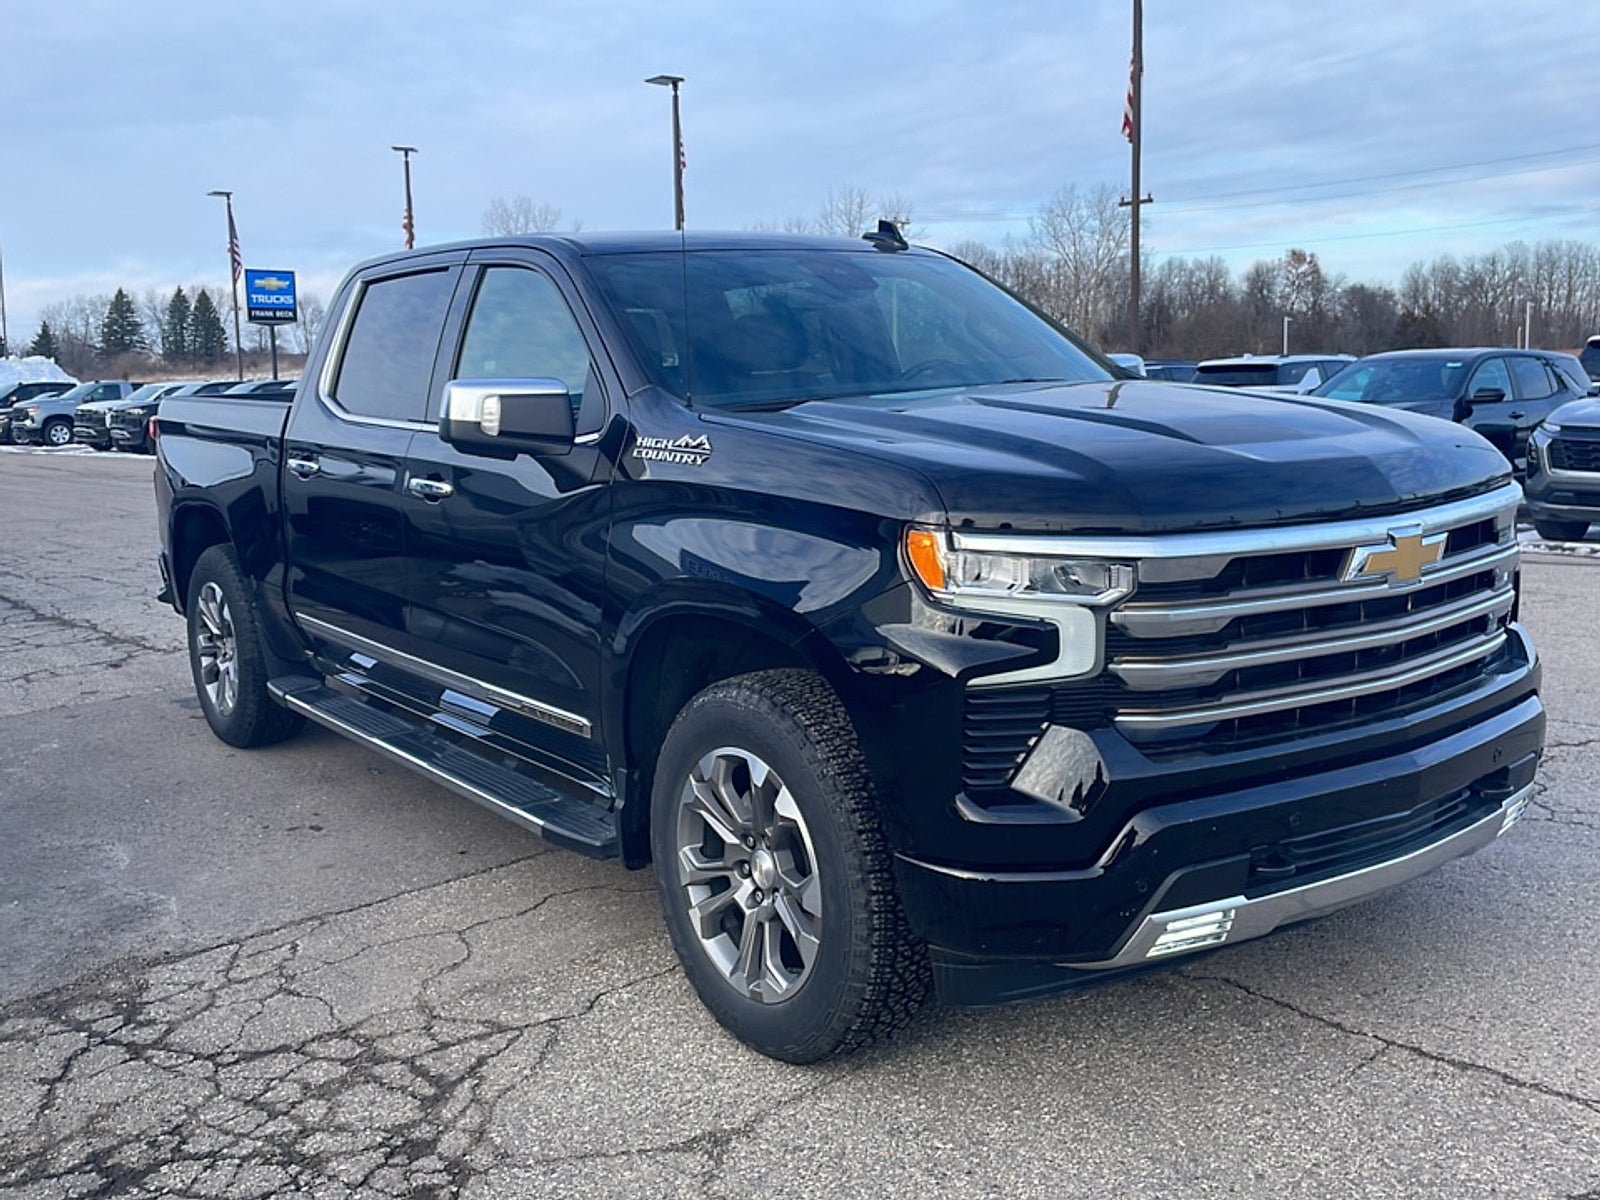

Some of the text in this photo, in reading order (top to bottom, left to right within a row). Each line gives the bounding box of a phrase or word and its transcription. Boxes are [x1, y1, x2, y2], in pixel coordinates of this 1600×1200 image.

[250, 294, 294, 305] TRUCKS
[636, 436, 674, 450] HIGH
[632, 448, 711, 465] COUNTRY
